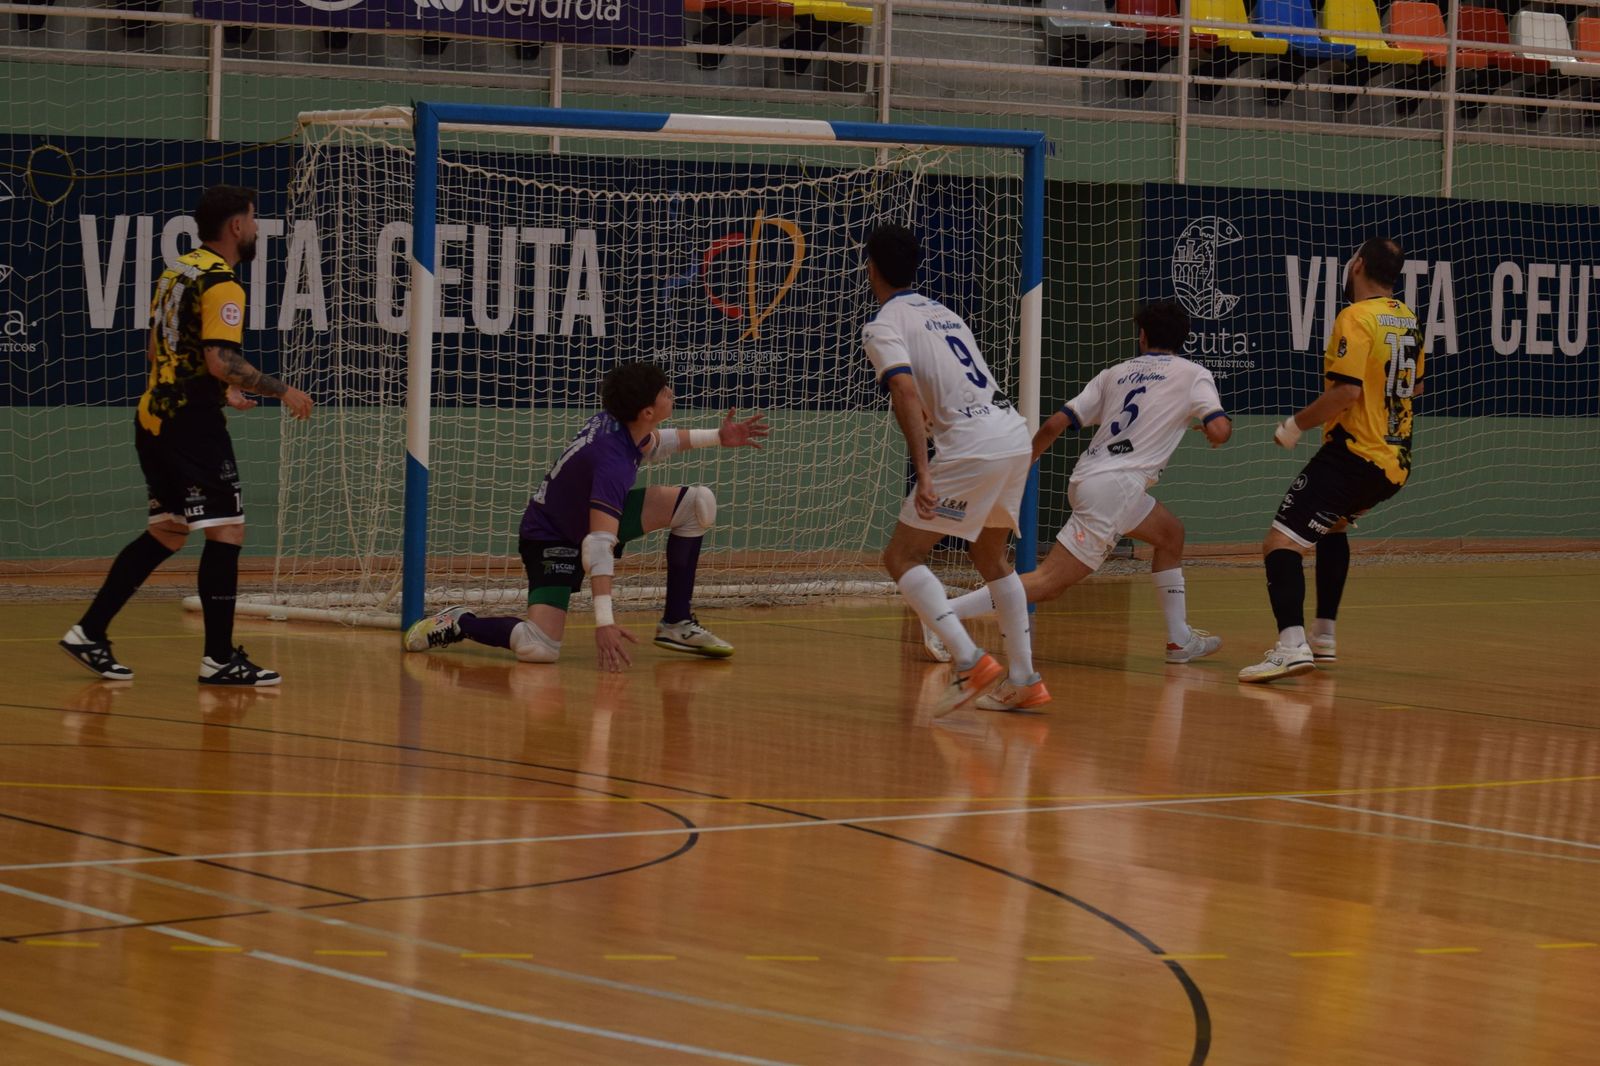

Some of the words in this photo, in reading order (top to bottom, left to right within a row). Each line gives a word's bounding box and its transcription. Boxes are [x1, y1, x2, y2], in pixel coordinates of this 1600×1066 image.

[375, 221, 606, 337] CEUTA
[1286, 255, 1458, 354] VITA
[1490, 261, 1600, 356] CEU
[945, 335, 987, 389] 9
[1384, 333, 1416, 398] 15
[1111, 386, 1146, 436] 5
